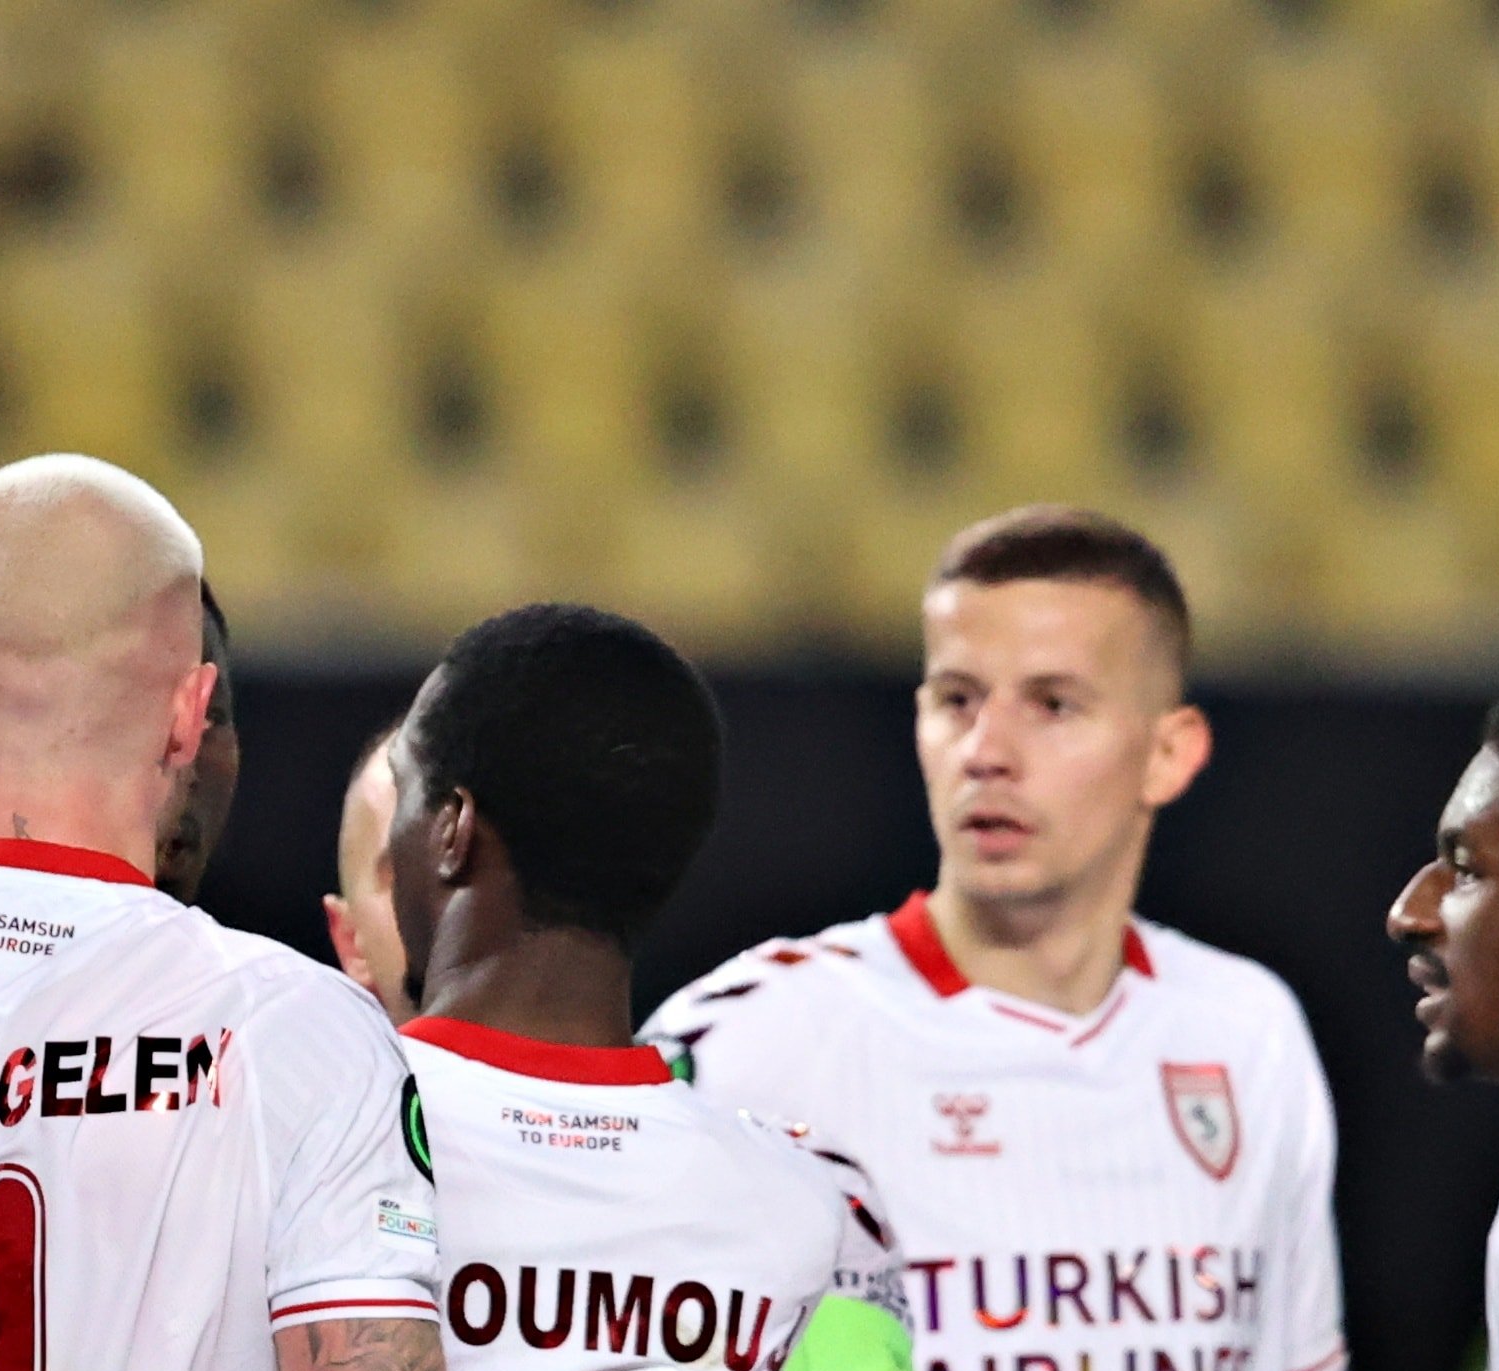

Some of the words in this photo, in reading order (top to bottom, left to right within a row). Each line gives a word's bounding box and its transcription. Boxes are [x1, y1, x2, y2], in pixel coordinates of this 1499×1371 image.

[501, 1107, 553, 1127] FROM
[558, 1114, 639, 1131] SAMSUN
[519, 1130, 542, 1144] TO
[548, 1133, 622, 1151] EUROPE
[905, 1246, 1264, 1332] TURKISH
